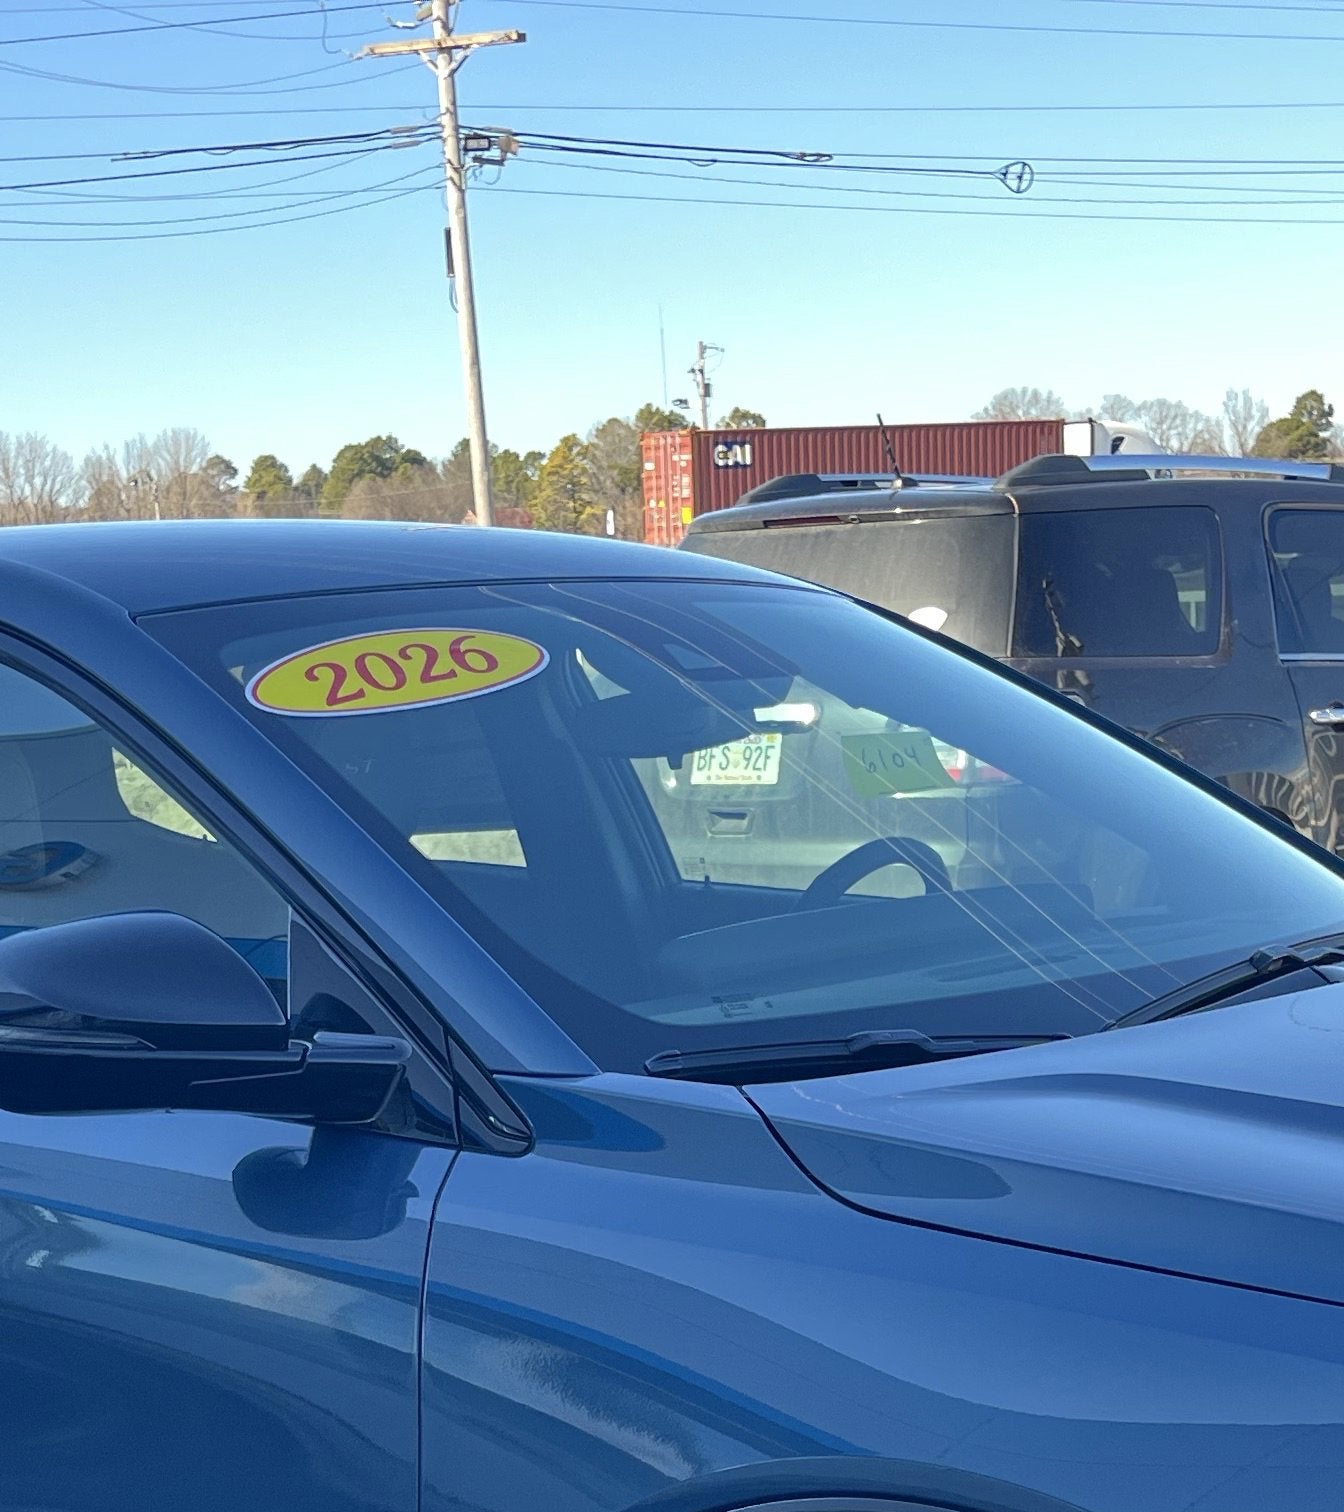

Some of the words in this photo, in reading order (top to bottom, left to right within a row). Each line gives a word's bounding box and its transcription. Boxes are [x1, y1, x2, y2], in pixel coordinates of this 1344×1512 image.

[304, 635, 499, 706] 2026
[697, 746, 731, 771] BFS
[743, 745, 775, 771] 92F
